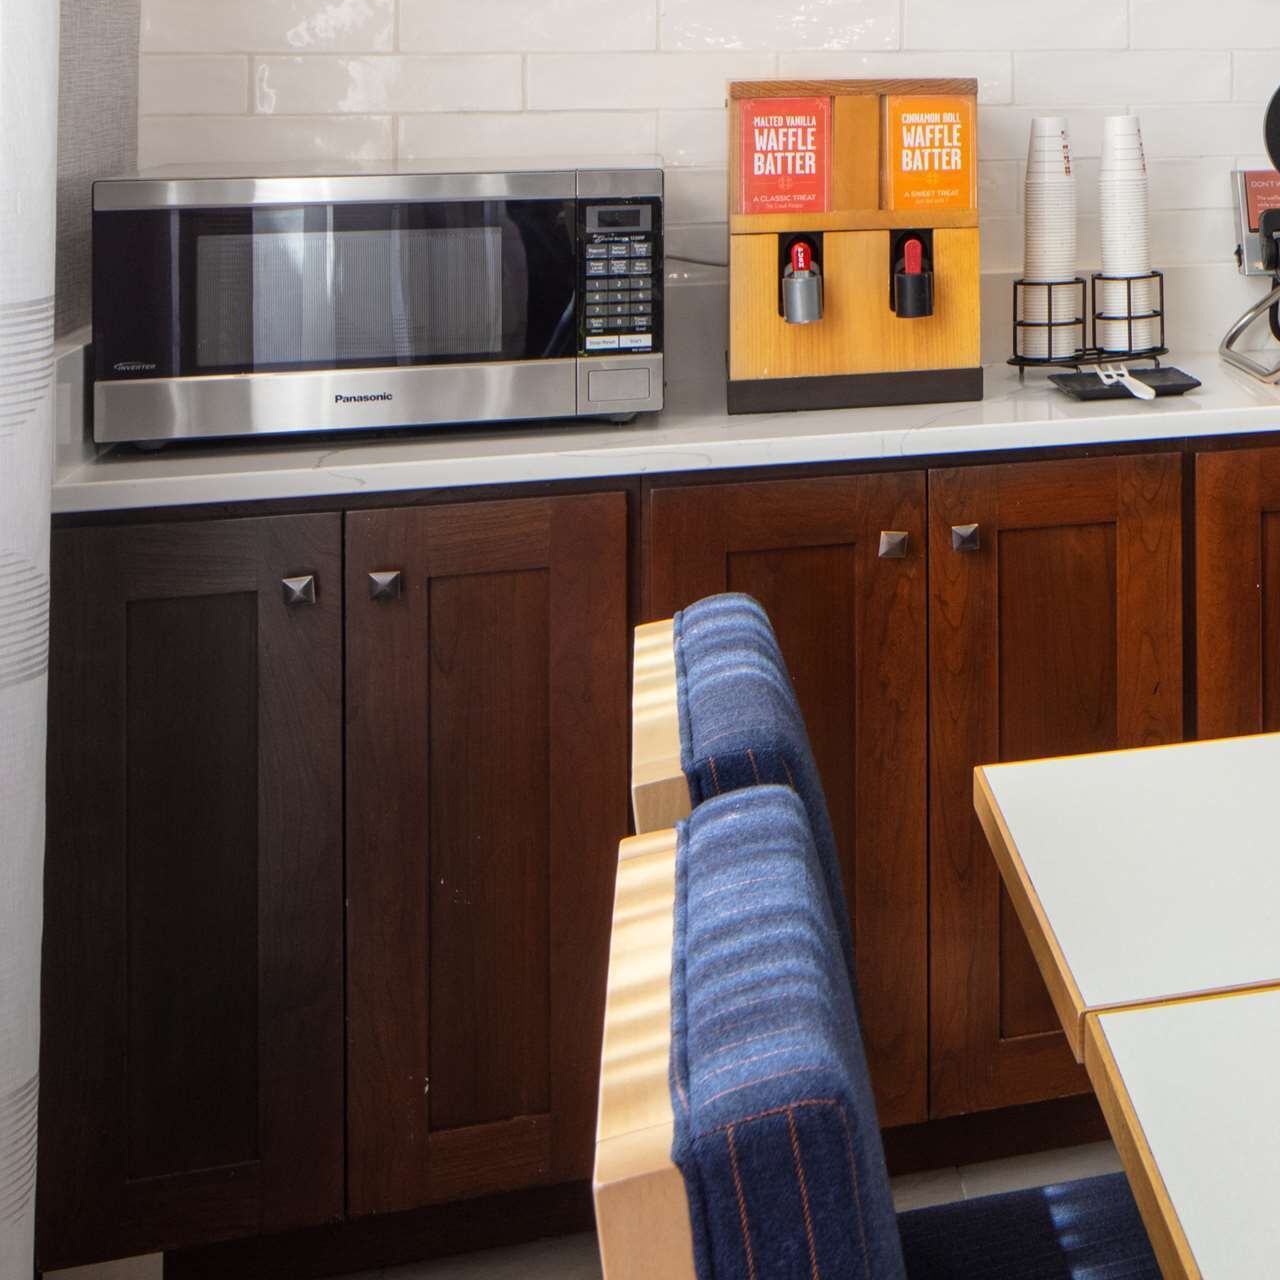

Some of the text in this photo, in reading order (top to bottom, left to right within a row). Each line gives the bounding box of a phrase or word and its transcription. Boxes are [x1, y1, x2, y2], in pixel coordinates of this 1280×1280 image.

[753, 116, 816, 127] MALTED VANILLA
[754, 128, 816, 151] WAFFLE
[902, 124, 962, 147] WAFFLE
[754, 152, 816, 175] BATTER
[902, 148, 961, 171] BATTER
[335, 392, 393, 403] Panasonic
